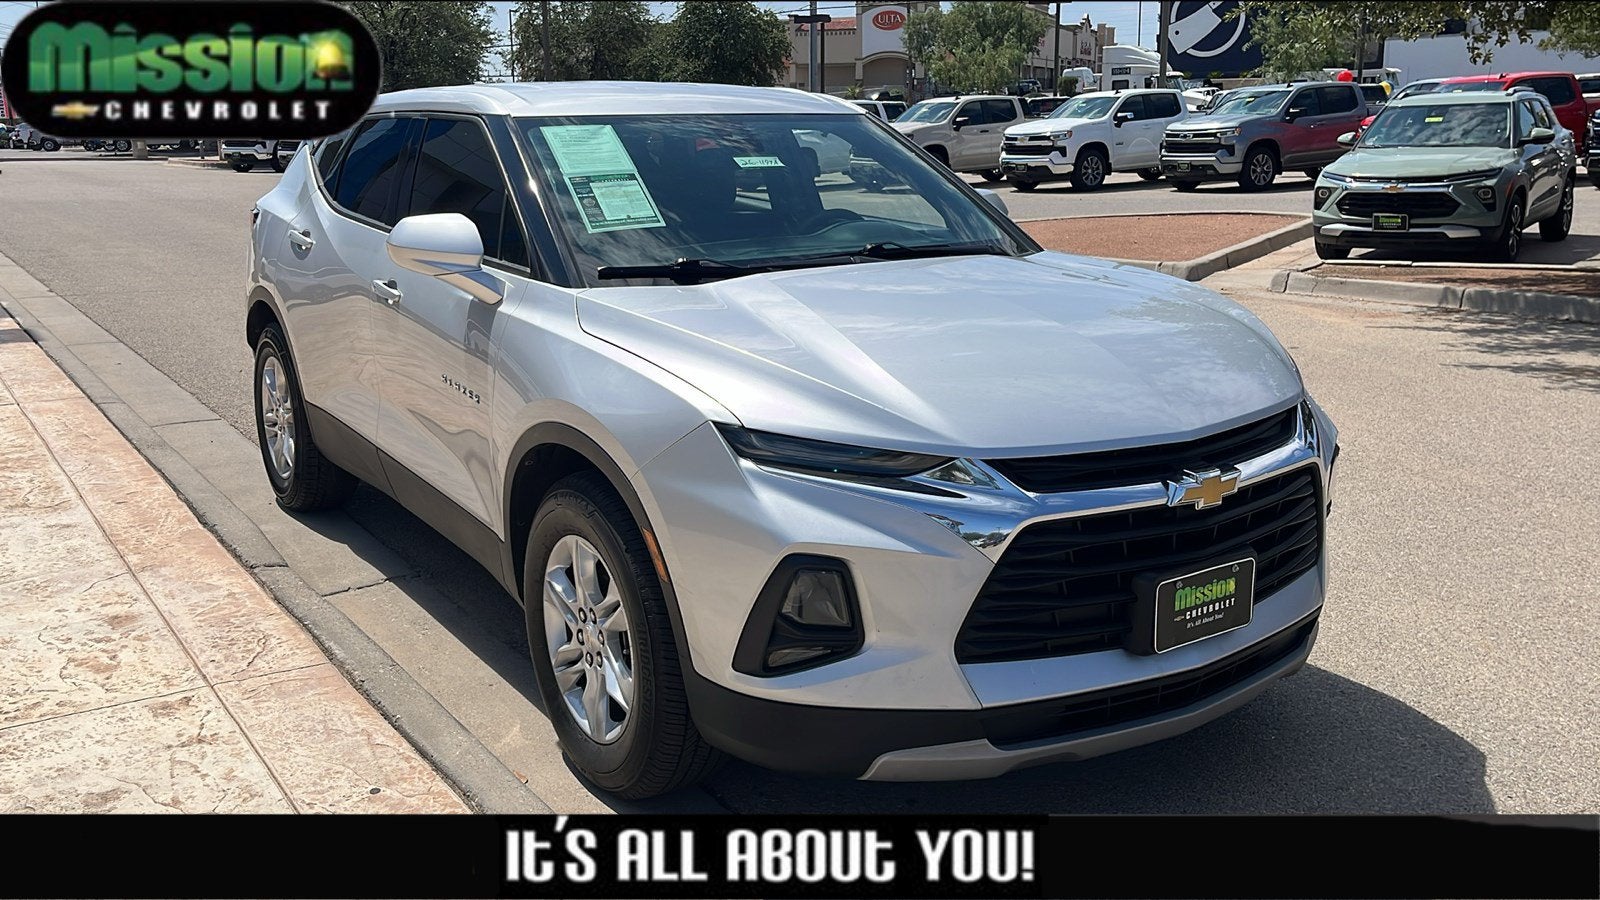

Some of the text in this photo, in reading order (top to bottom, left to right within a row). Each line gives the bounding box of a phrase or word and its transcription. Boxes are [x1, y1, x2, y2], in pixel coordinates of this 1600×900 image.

[878, 14, 902, 23] ULTA
[1174, 577, 1236, 612] Mission
[1185, 597, 1235, 620] CHEVROLET
